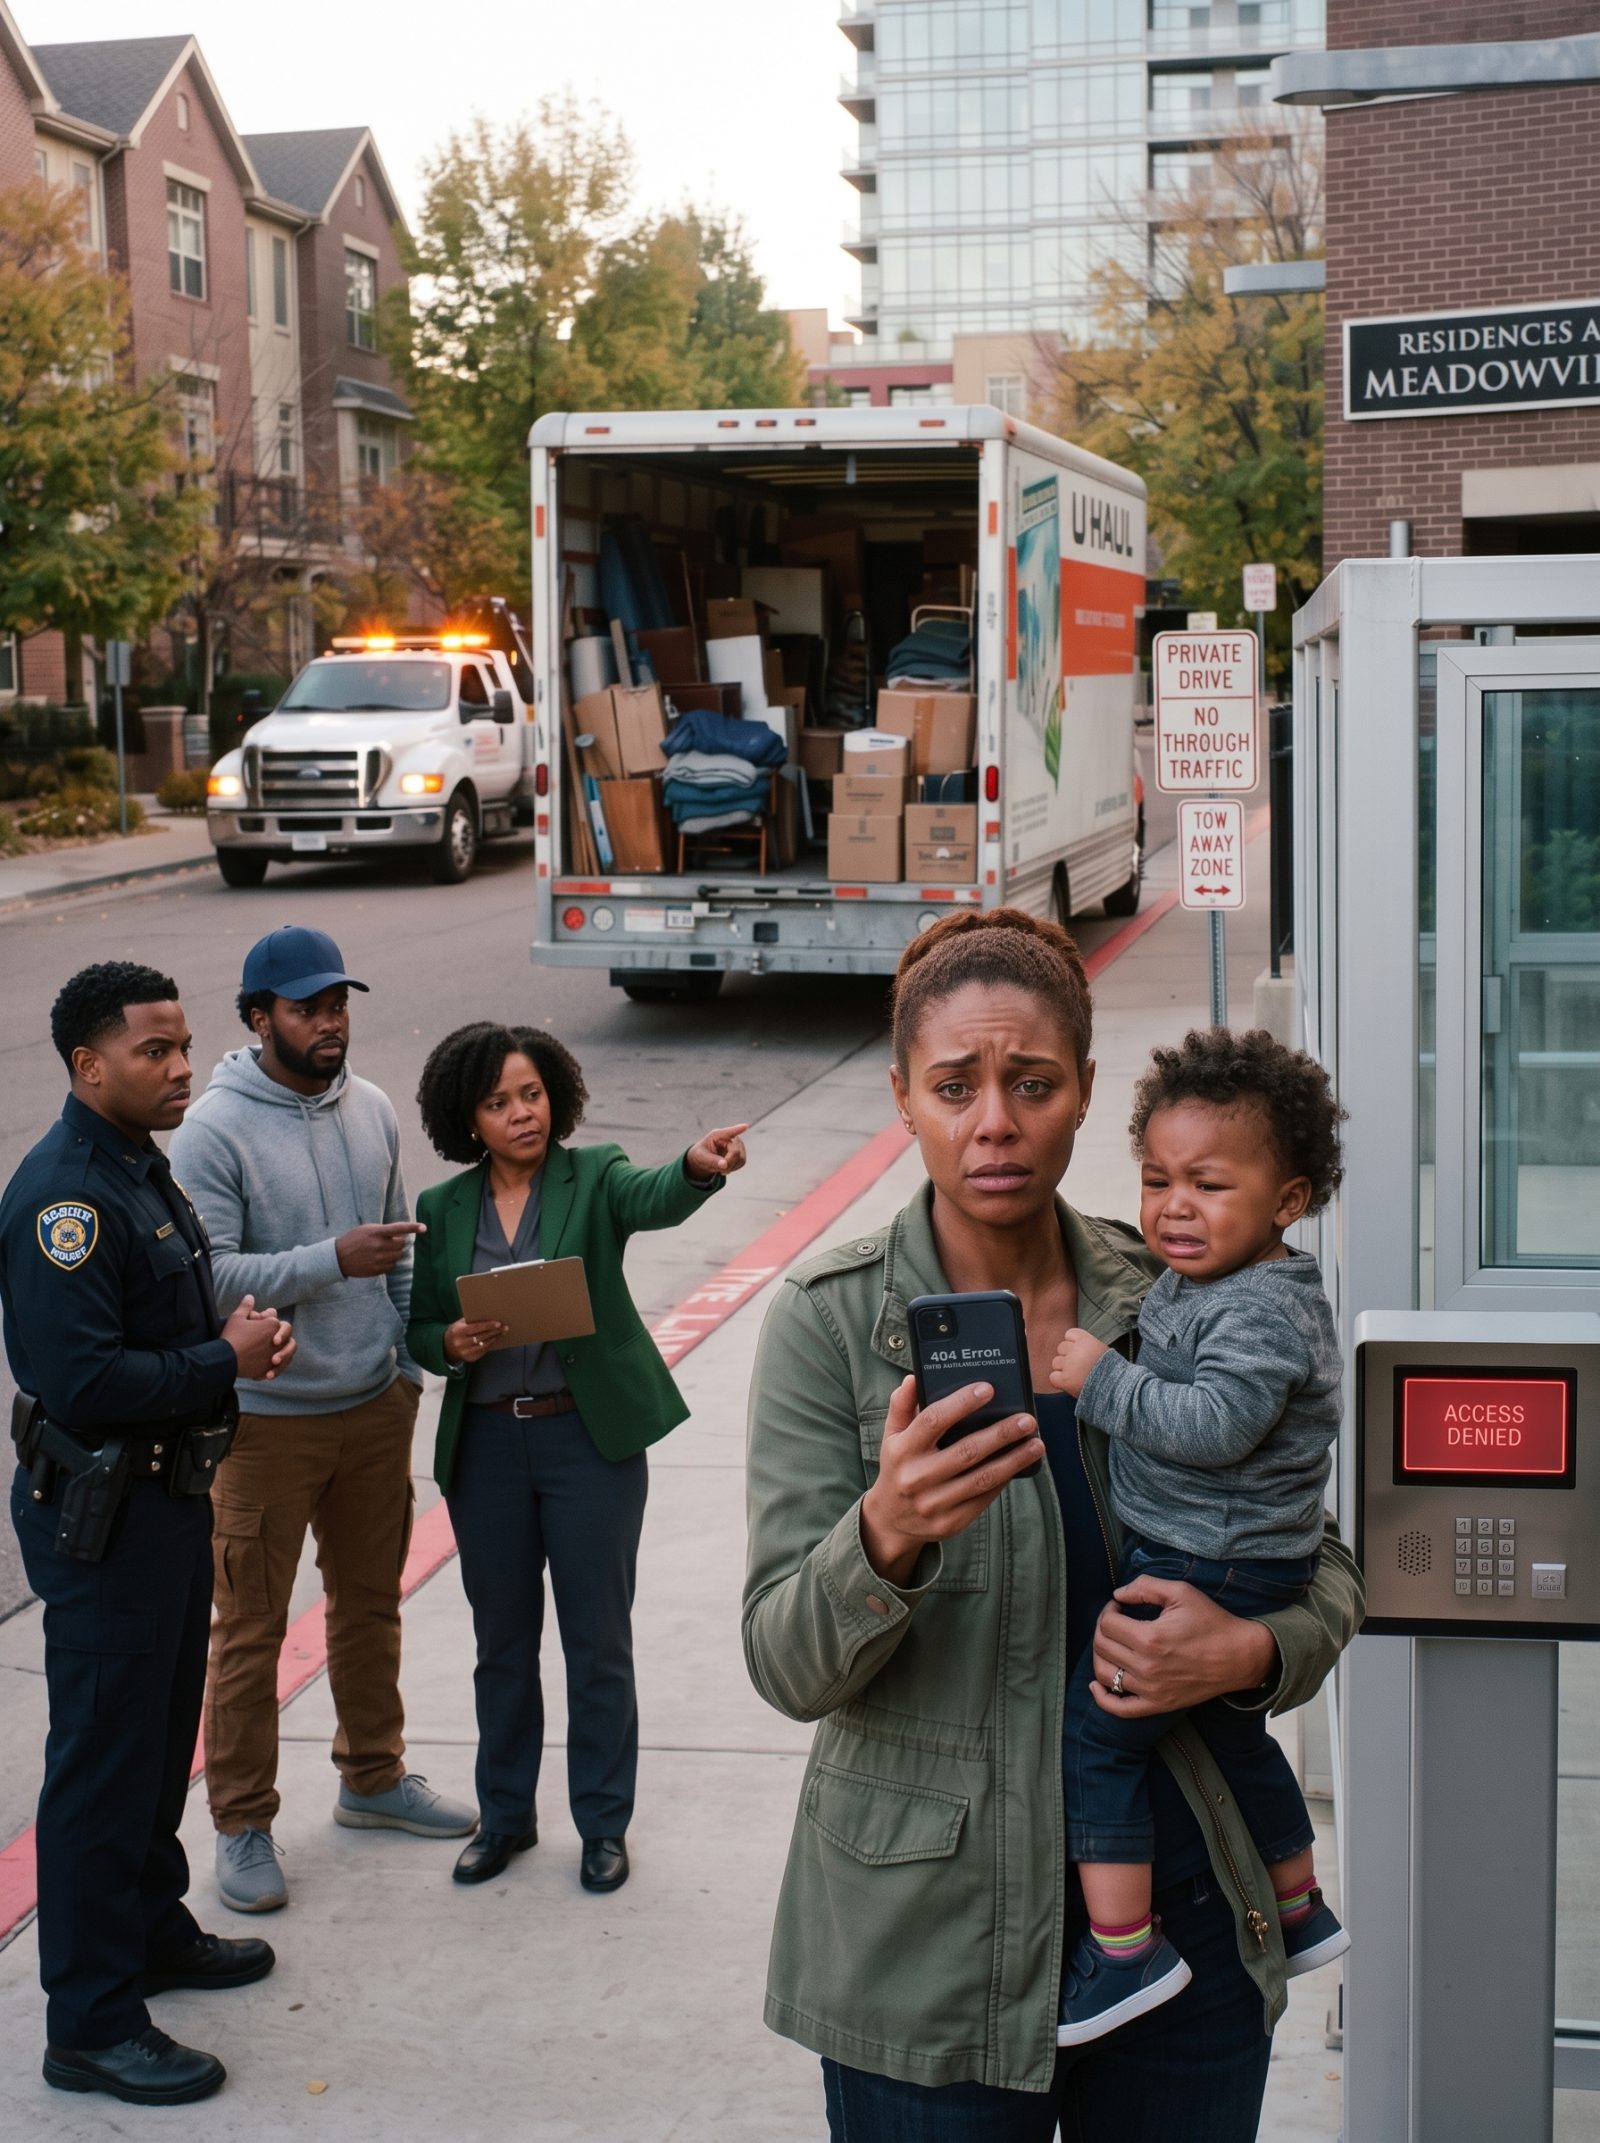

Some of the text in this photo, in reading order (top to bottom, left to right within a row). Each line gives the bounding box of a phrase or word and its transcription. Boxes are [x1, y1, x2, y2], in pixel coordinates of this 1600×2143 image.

[1398, 320, 1573, 356] RESIDENCES
[1364, 353, 1600, 400] MEADOWVI
[1168, 643, 1242, 663] PRIVATE
[1179, 670, 1233, 689] DRIVE
[1194, 706, 1219, 726] NO
[1163, 732, 1249, 752] THROUGH
[1170, 759, 1243, 779] TRAFFIC
[1193, 811, 1227, 829] TOW
[1190, 835, 1233, 853] AWAY
[1190, 859, 1233, 876] ZONE
[930, 1350, 957, 1362] 404
[1444, 1404, 1525, 1424] ACCESS
[1447, 1427, 1522, 1447] DENIED
